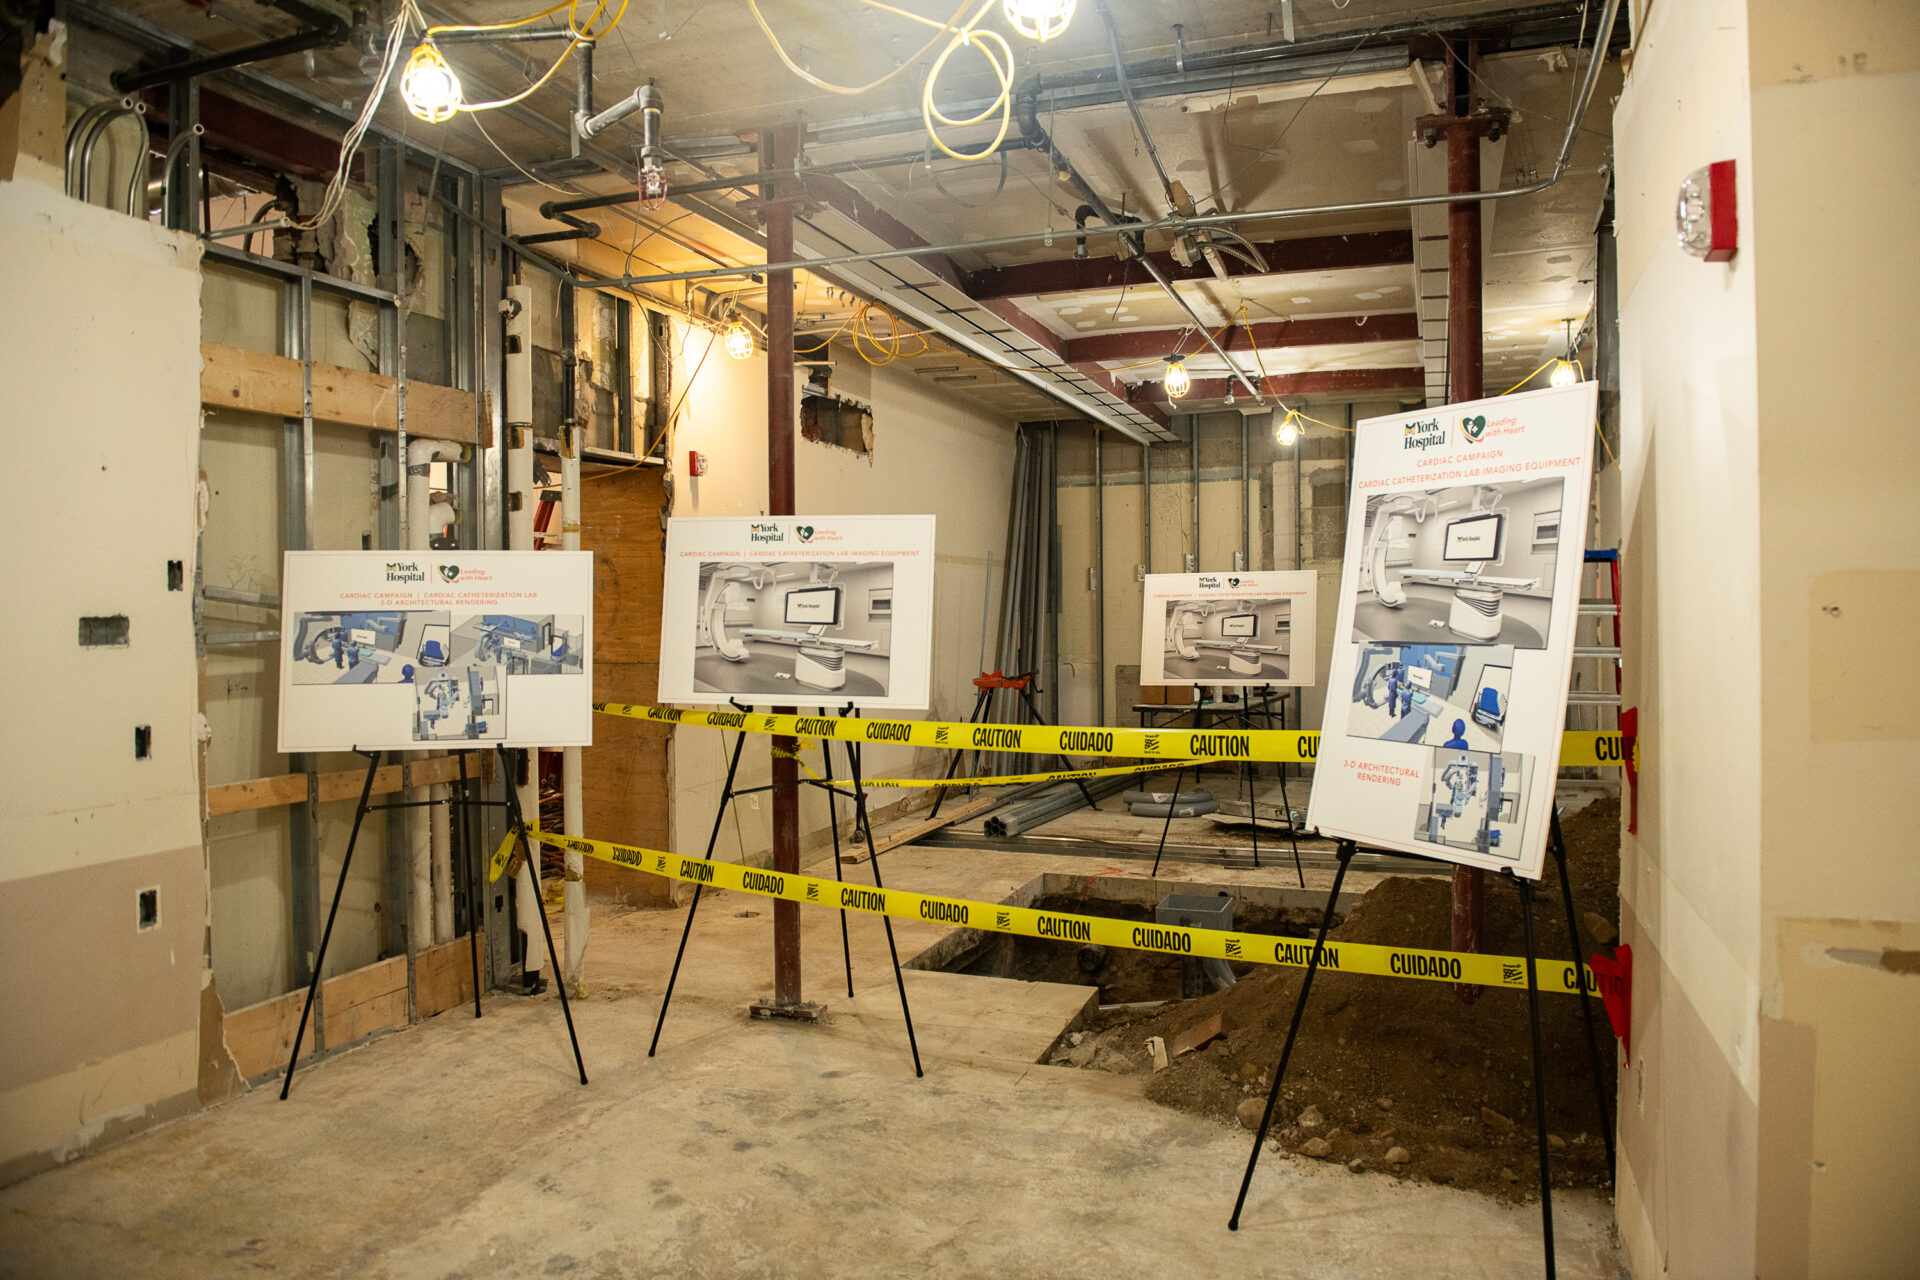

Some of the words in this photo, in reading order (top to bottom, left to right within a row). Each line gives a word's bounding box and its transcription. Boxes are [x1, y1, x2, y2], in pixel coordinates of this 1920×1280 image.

[1415, 418, 1439, 433] York
[1486, 416, 1517, 428] Leading
[1485, 428, 1501, 437] with
[1503, 426, 1525, 436] Heart
[1404, 432, 1445, 451] Hospital
[1416, 455, 1453, 467] CARDIAC
[1456, 450, 1504, 463] CAMPAIGN
[1358, 477, 1390, 488] CARDIAC
[1392, 471, 1461, 485] CATHETERIZATION
[1464, 469, 1480, 477] LAB
[1483, 464, 1522, 476] IMAGING
[1525, 456, 1582, 471] EQUIPMENT
[760, 523, 779, 533] York
[751, 533, 784, 544] Hospital
[396, 562, 418, 572] York
[386, 572, 425, 584] Hospital
[648, 708, 684, 721] CAUTION
[706, 711, 747, 728] CUIDADO
[795, 717, 838, 736] CAUTION
[866, 722, 912, 742] CUIDADO
[972, 727, 1022, 749] CAUTION
[1059, 730, 1113, 752] CUIDADO
[1190, 734, 1250, 757] CAUTION
[1297, 736, 1320, 758] CU
[1343, 760, 1356, 769] 3-D
[1357, 762, 1419, 778] ARCHITECTURAL
[1356, 772, 1401, 786] RENDERING
[680, 860, 714, 883] CAUTION
[742, 871, 785, 895] CUIDADO
[841, 888, 886, 912] CAUTION
[920, 899, 969, 925] CUIDADO
[1037, 916, 1091, 942] CAUTION
[1132, 927, 1192, 953] CUIDADO
[1390, 953, 1462, 980] CUIDADO
